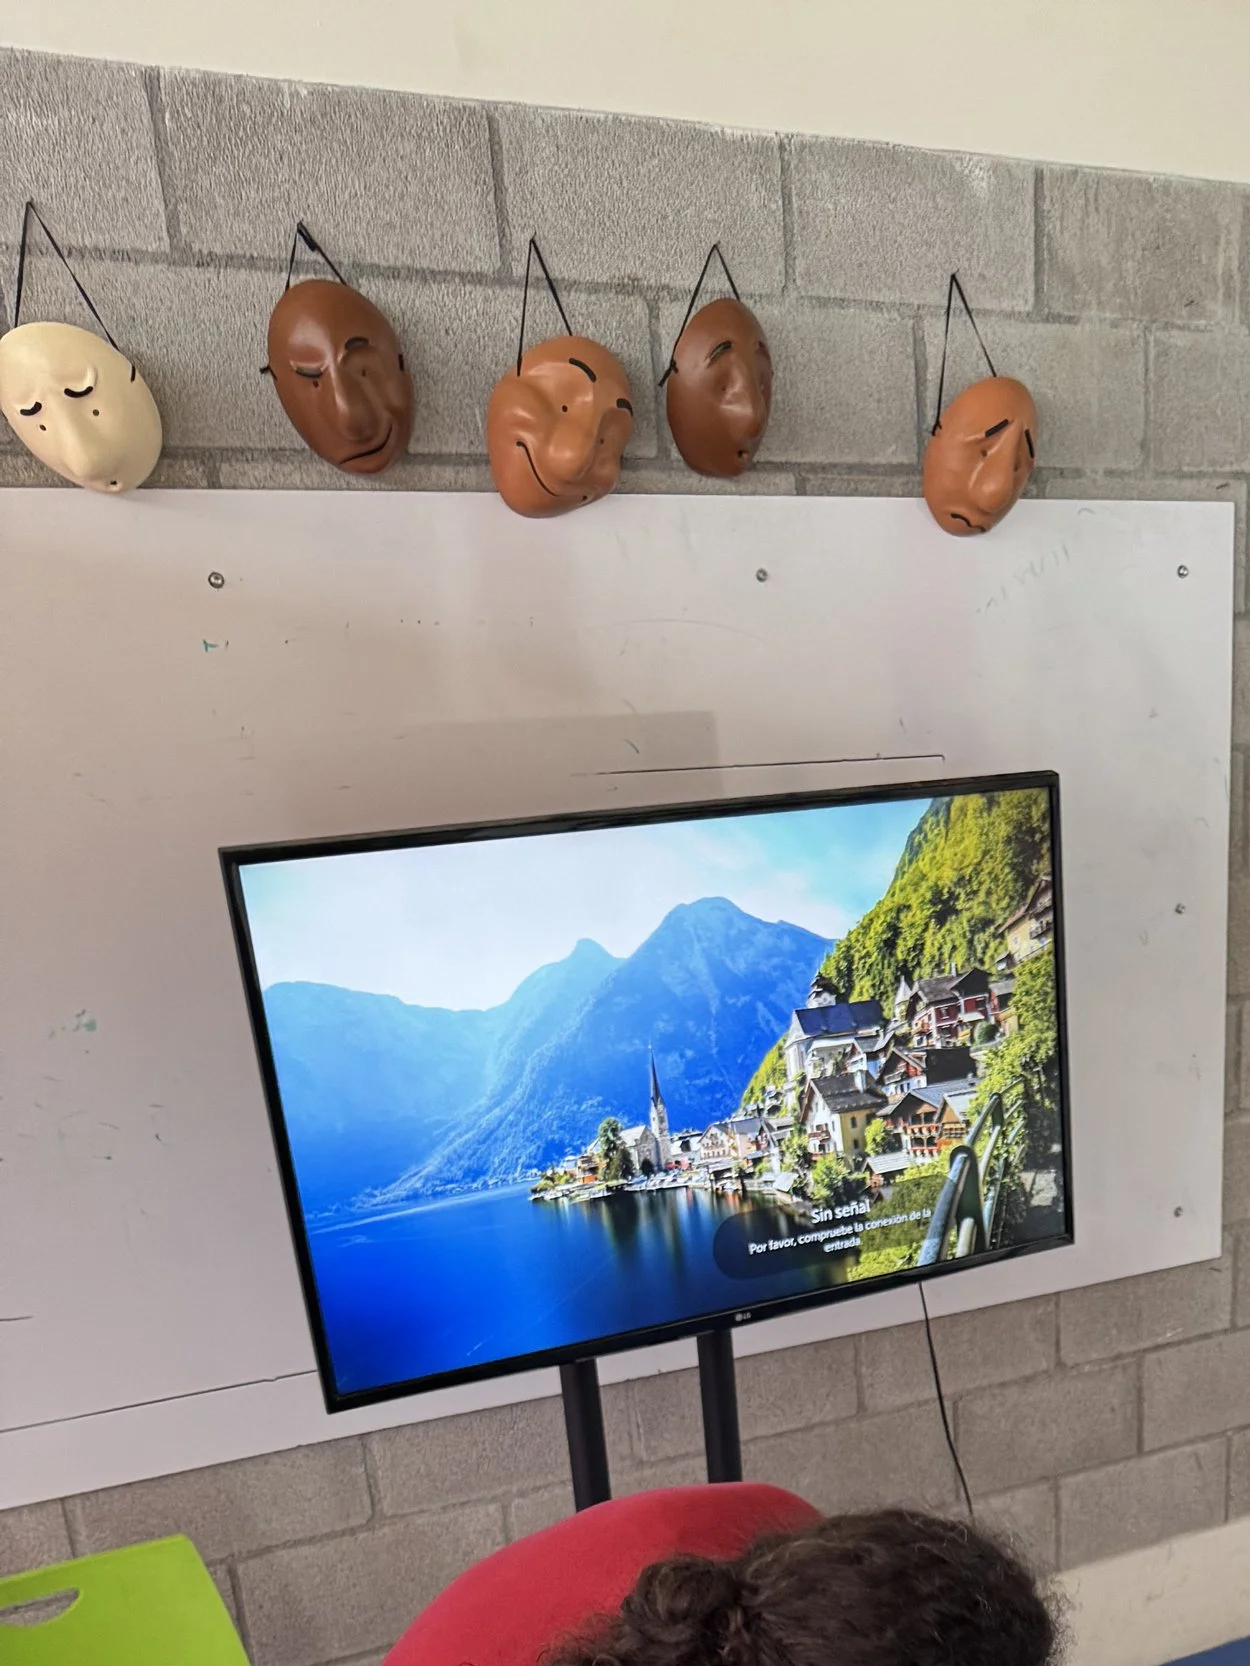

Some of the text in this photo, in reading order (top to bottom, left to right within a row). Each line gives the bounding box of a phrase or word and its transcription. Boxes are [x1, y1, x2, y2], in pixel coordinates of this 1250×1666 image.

[811, 1199, 871, 1224] Sin señal
[748, 1208, 931, 1255] Por favor, compruebe la conexión de la
